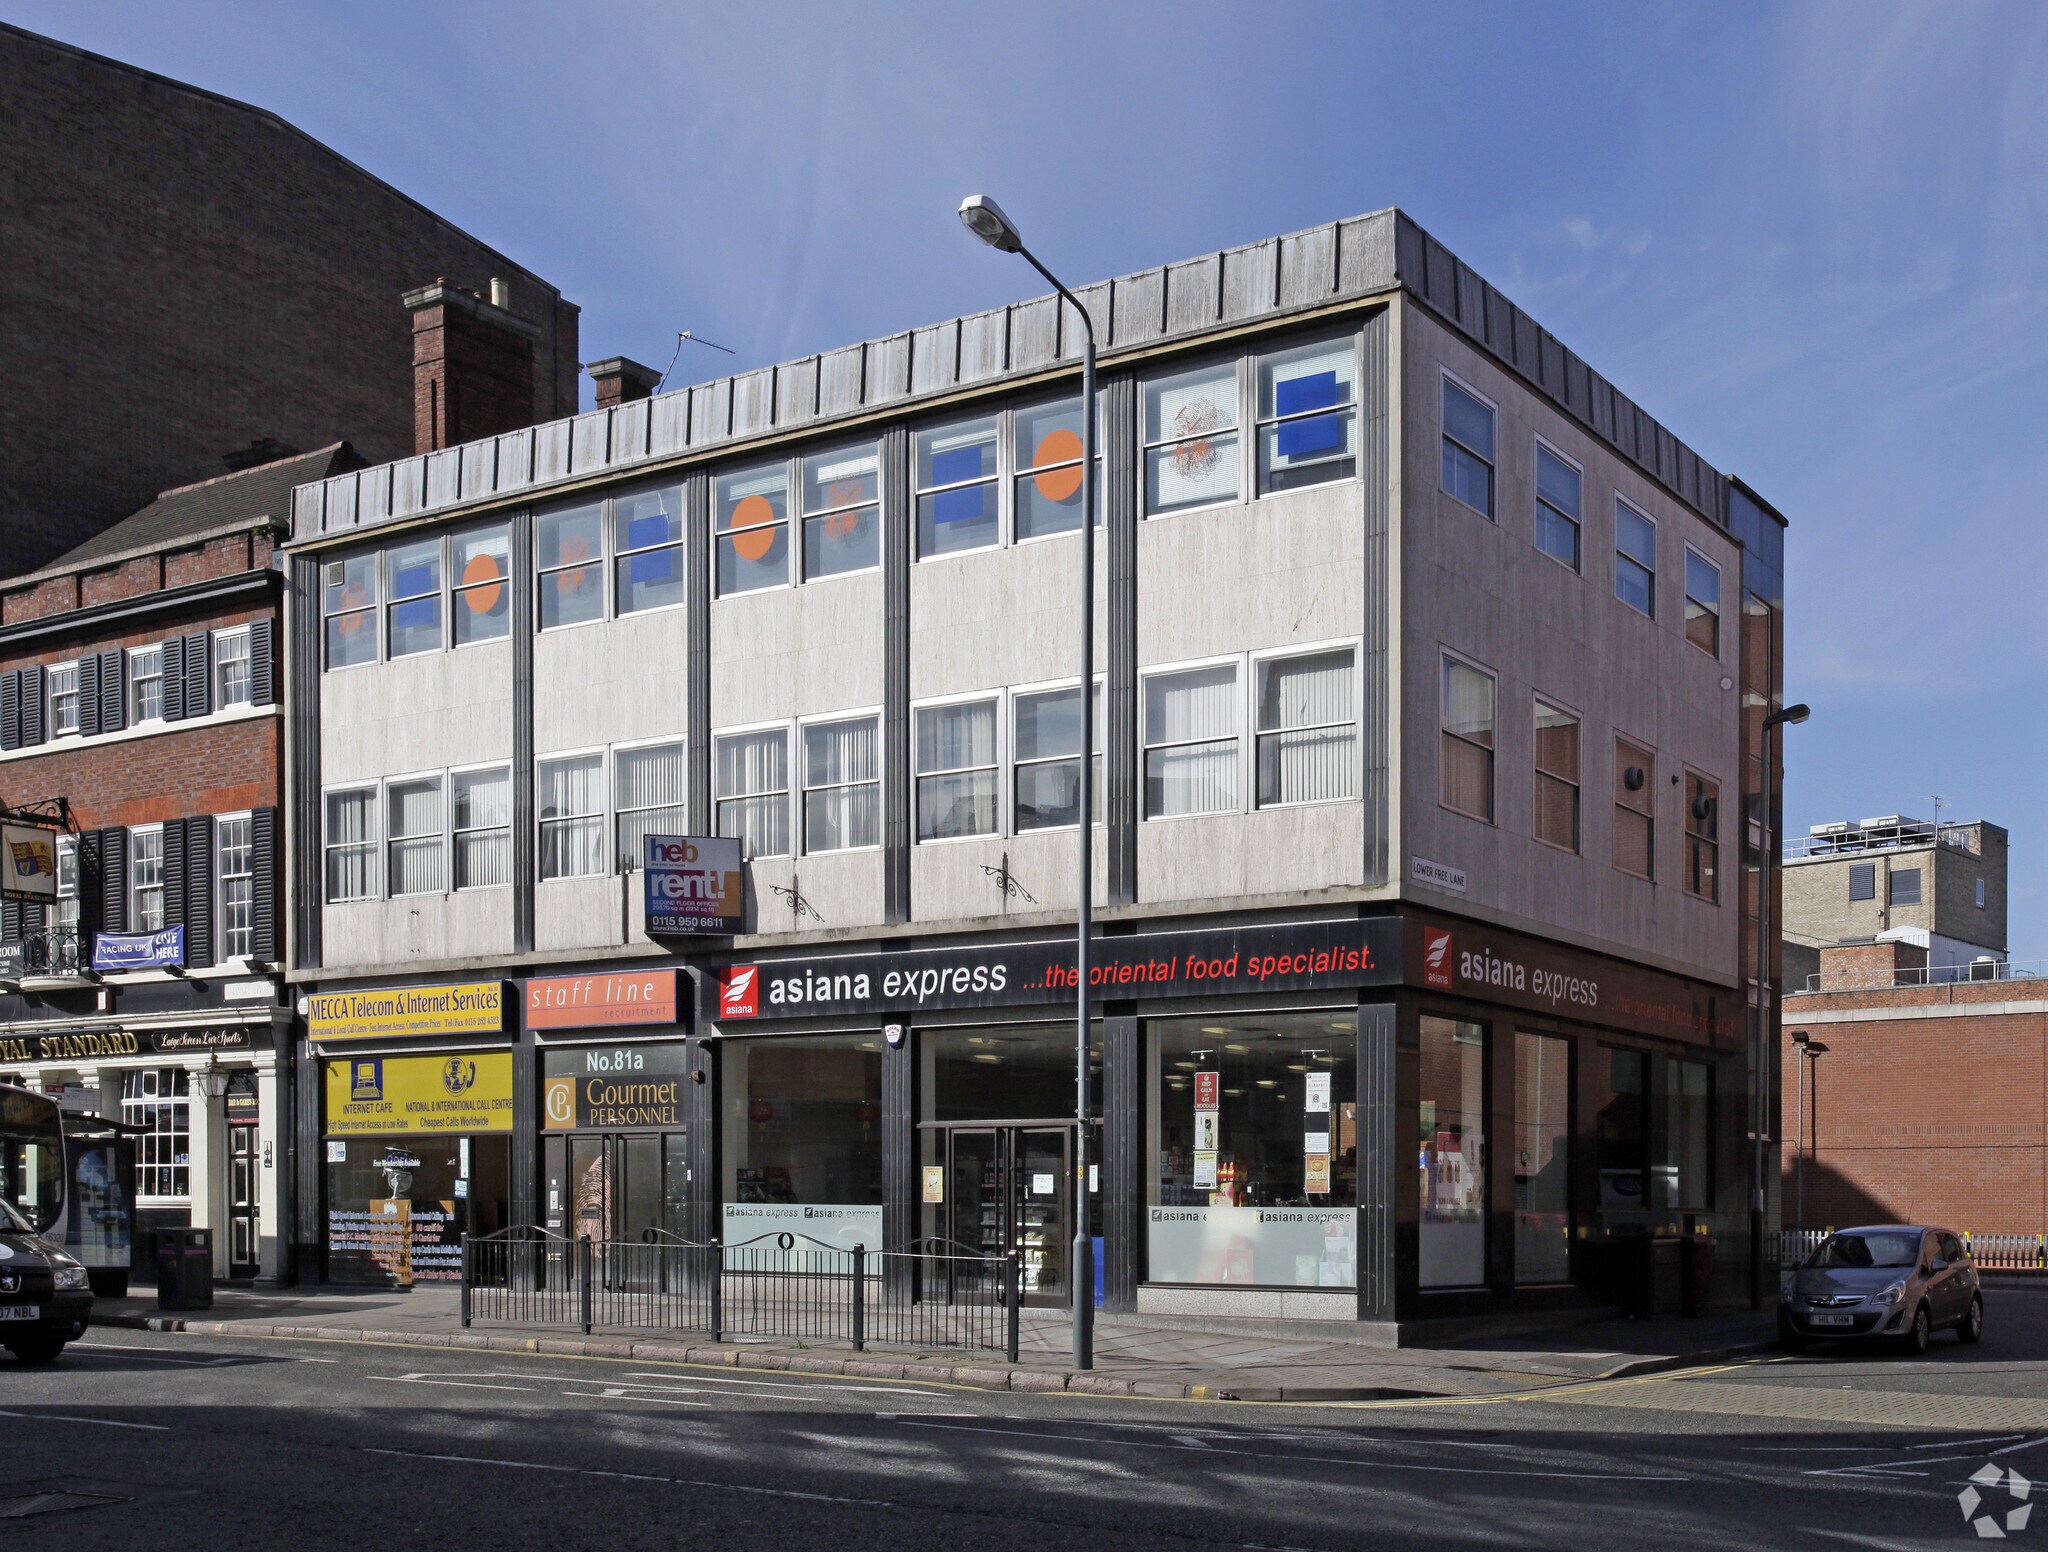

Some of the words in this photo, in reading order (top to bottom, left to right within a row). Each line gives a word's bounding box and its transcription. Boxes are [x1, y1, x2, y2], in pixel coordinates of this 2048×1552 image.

[650, 838, 698, 862] heb
[1413, 862, 1433, 879] LOWER
[1434, 867, 1448, 882] FREE
[1450, 871, 1465, 887] LANE
[651, 869, 726, 899] rent!
[652, 915, 676, 926] 0115
[678, 916, 698, 926] 950
[700, 917, 723, 928] 6611
[156, 932, 178, 945] LIVE
[101, 944, 132, 954] RACING
[135, 943, 147, 952] UK
[156, 946, 179, 960] HERE
[1090, 956, 1176, 984] oriental
[1185, 952, 1240, 980] food
[1247, 945, 1376, 978] specialist.
[1428, 972, 1448, 985] asiana
[1460, 947, 1525, 991] asiana
[1532, 968, 1598, 1006] express
[770, 969, 870, 1004] asiana
[882, 964, 1007, 1003] express
[532, 980, 592, 1008] staff
[606, 978, 654, 1003] line
[310, 997, 348, 1021] MECCA
[350, 996, 394, 1018] Telecom
[396, 993, 404, 1014] &
[407, 992, 450, 1014] Internet
[452, 988, 499, 1011] Services
[726, 1003, 752, 1015] asiana
[604, 1006, 667, 1019] recruitment
[40, 1032, 138, 1059] STANDARD
[161, 1033, 179, 1049] Large
[202, 1031, 218, 1044] Live
[218, 1030, 242, 1046] Sports
[586, 1050, 644, 1072] No.81a
[586, 1078, 678, 1106] Gourmet
[342, 1103, 374, 1114] INTERNET
[376, 1102, 392, 1113] CAFE
[406, 1101, 430, 1112] NATIONAL
[431, 1102, 436, 1112] &
[436, 1100, 476, 1112] INTERNATIONAL
[477, 1100, 491, 1110] CALL
[492, 1098, 512, 1110] CENTRE
[420, 1117, 444, 1129] Cheapest
[446, 1116, 460, 1128] Calls
[460, 1116, 488, 1126] Worldwide
[590, 1106, 679, 1126] PERSONNEL
[338, 1120, 350, 1131] Speed
[350, 1120, 366, 1128] Internet
[367, 1119, 381, 1128] Access
[382, 1120, 386, 1128] at
[387, 1120, 396, 1128] Low
[396, 1118, 408, 1128] Rates
[736, 1206, 763, 1216] asiana
[766, 1209, 798, 1218] express
[814, 1208, 842, 1218] asiana
[1164, 1210, 1199, 1221] asiana
[1266, 1212, 1302, 1222] asiana
[14, 1306, 36, 1318] NBL
